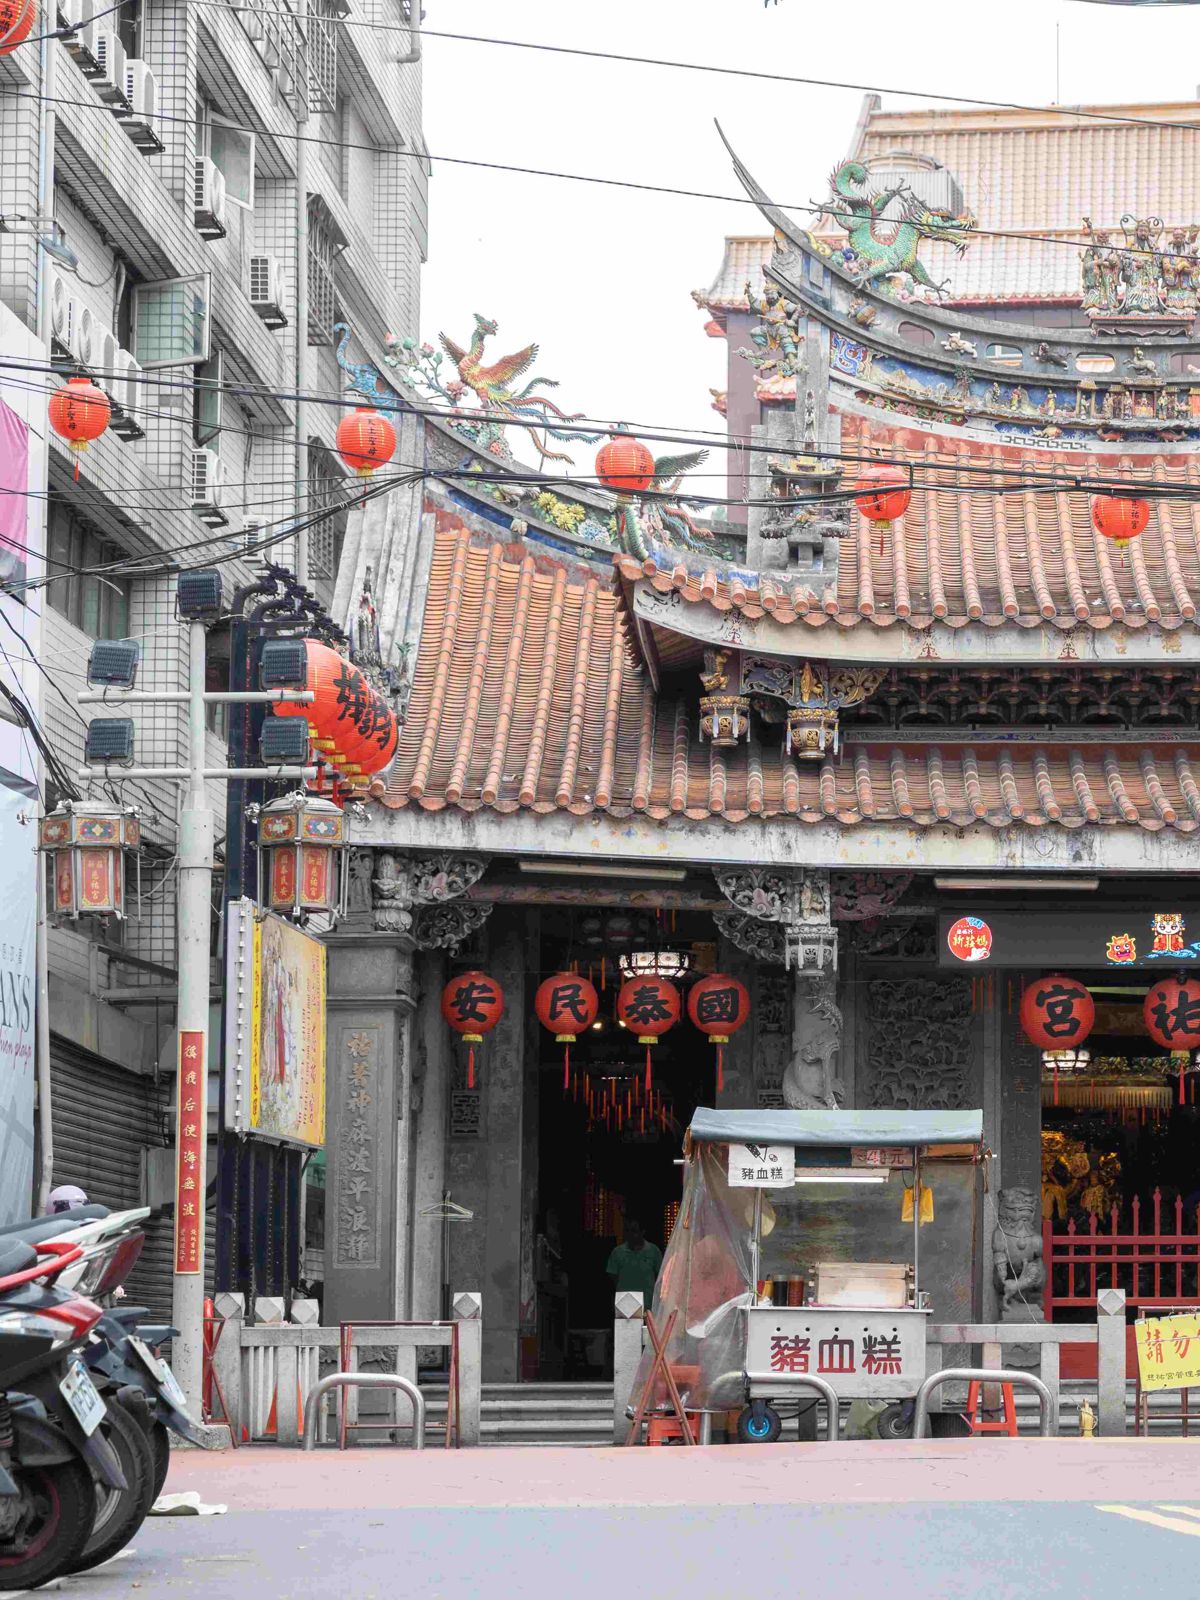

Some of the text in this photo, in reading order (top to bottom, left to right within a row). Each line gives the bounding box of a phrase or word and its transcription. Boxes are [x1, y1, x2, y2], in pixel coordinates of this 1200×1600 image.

[451, 983, 739, 1024] 國 泰 民 安
[1035, 984, 1087, 1038] 宮
[741, 1167, 783, 1180] 豬血糕
[771, 1334, 902, 1375] 豬血糕
